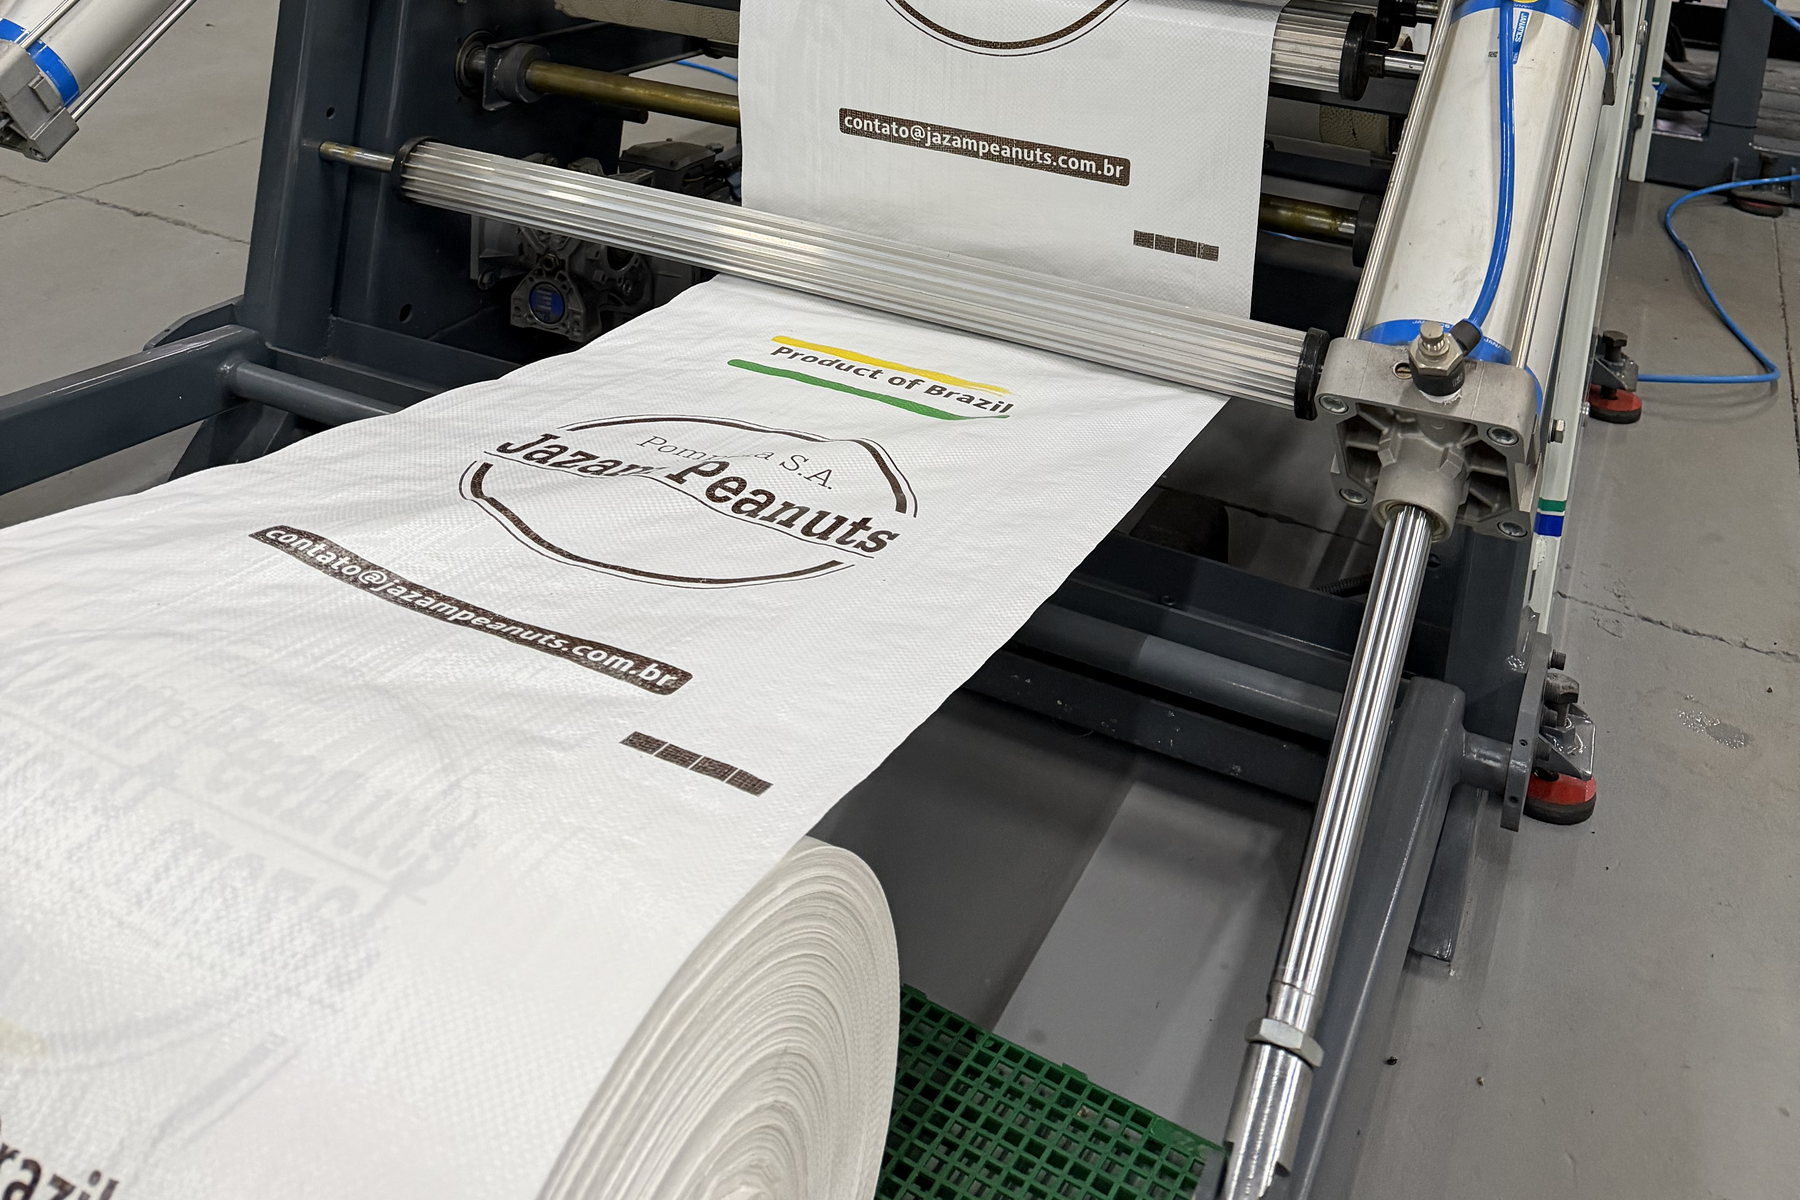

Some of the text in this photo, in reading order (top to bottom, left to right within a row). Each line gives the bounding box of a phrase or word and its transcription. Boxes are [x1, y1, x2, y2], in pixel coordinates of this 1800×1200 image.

[1514, 12, 1529, 42] JANATICS
[844, 115, 1124, 178] contato@jazampeanuts.com.br
[771, 345, 1015, 414] Product of Brazil
[779, 454, 833, 490] S.A.
[665, 460, 900, 553] Peanuts
[265, 527, 679, 688] contato@jazampeanuts.com.br
